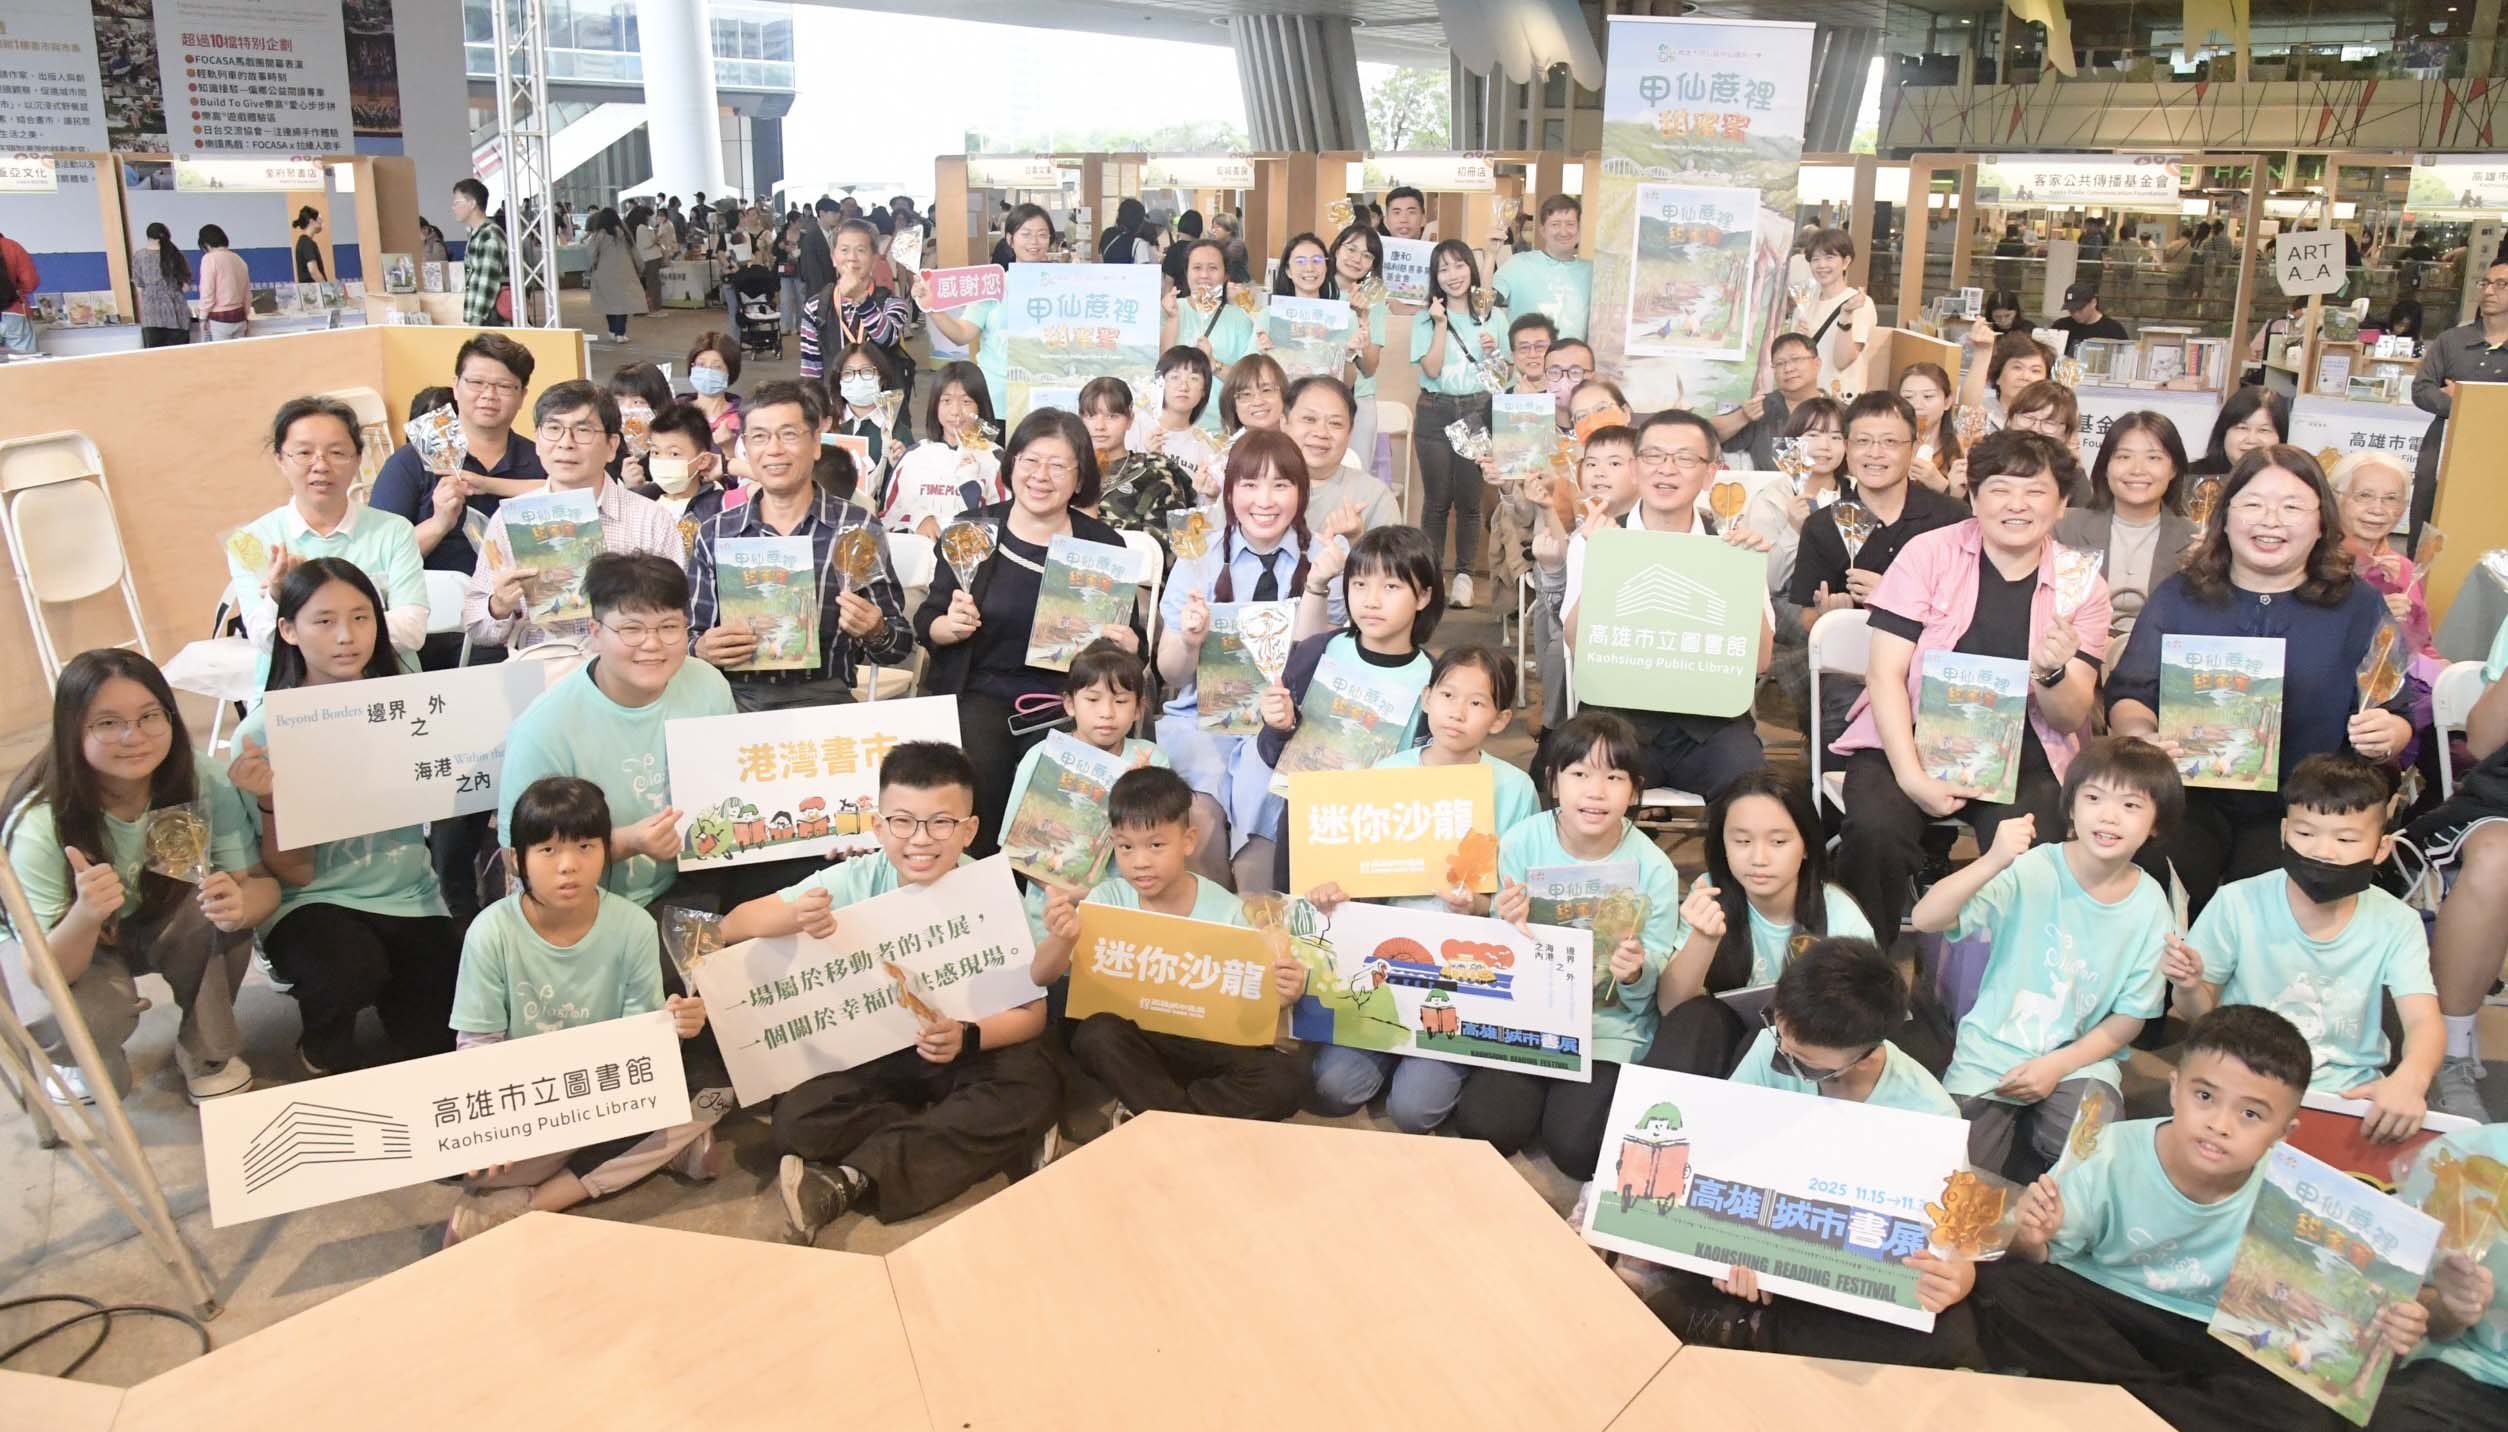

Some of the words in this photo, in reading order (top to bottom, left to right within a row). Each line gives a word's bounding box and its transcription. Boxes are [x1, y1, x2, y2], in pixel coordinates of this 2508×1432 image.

[181, 32, 293, 52] 超過10檔特別企劃
[200, 98, 226, 107] Build
[229, 99, 241, 107] To
[1639, 72, 1775, 111] 甲仙蔗裡
[2034, 174, 2169, 188] 客家公共傳播基金會
[2288, 243, 2333, 261] ART
[937, 270, 1001, 299] 感謝您
[1027, 292, 1139, 324] 甲仙蔗裡
[1588, 623, 1748, 657] 高雄市立圖書館
[1586, 652, 1653, 670] Kaohsiung
[1656, 656, 1695, 671] Public
[1698, 661, 1745, 676] Library
[276, 711, 319, 729] Beyond
[321, 705, 364, 721] Borders
[367, 699, 407, 724] 邊界
[428, 694, 446, 714] 外
[410, 717, 429, 737] 之
[414, 757, 452, 781] 海港
[453, 752, 488, 766] Within
[737, 730, 898, 782] 港灣書市
[456, 771, 491, 794] 之內
[1308, 798, 1473, 845] 迷你沙龍
[725, 912, 986, 1012] 一場屬於移動者的書展，
[1091, 936, 1266, 1001] 迷你沙龍
[1462, 1022, 1497, 1040] 高雄
[1504, 1029, 1579, 1053] 城市書展
[432, 1056, 654, 1129] 高雄市立圖書館
[438, 1121, 533, 1152] Kaohsiung
[538, 1107, 591, 1131] Public
[595, 1095, 657, 1118] Library
[1808, 1177, 1848, 1197] 2025
[1690, 1178, 1762, 1220] 高雄
[1770, 1197, 1928, 1258] 城市書展
[1694, 1241, 1770, 1273] KAOHSIUNG
[1773, 1259, 1831, 1286] READING
[1836, 1275, 1898, 1303] FESTIVAL
